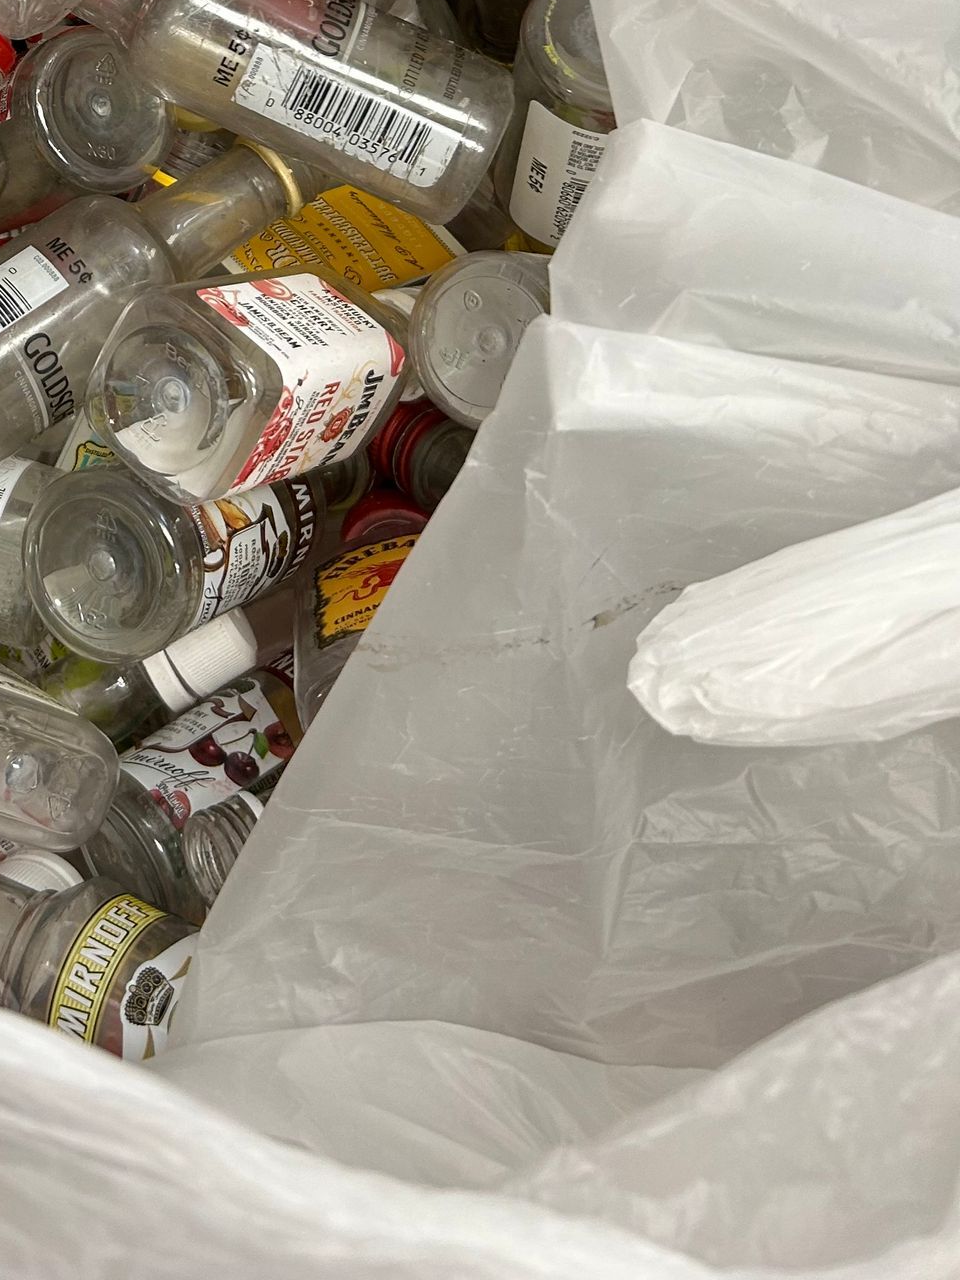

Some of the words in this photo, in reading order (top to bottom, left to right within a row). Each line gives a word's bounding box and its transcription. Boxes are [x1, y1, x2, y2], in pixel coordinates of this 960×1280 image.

[212, 55, 240, 89] ME
[264, 96, 275, 108] 0
[292, 107, 345, 138] 88004
[347, 132, 401, 165] 03576
[527, 175, 542, 193] 5¢
[530, 157, 547, 177] ME
[557, 181, 575, 204] 80660
[553, 206, 568, 230] 62099
[7, 265, 18, 276] 0
[44, 231, 77, 265] ME
[66, 255, 97, 288] 5¢
[237, 294, 270, 327] JAMES
[272, 322, 302, 353] BEAM
[289, 292, 334, 338] CHERRY
[322, 290, 361, 330] INSPIRED
[322, 286, 330, 295] A
[329, 288, 376, 335] KENTUCKY
[24, 332, 74, 423] GOLDSCH
[352, 368, 384, 410] JIM
[305, 375, 341, 429] RED
[274, 482, 314, 580] MIRNO
[320, 536, 417, 582] FIREBA
[53, 894, 151, 1039] MIRNOFF
